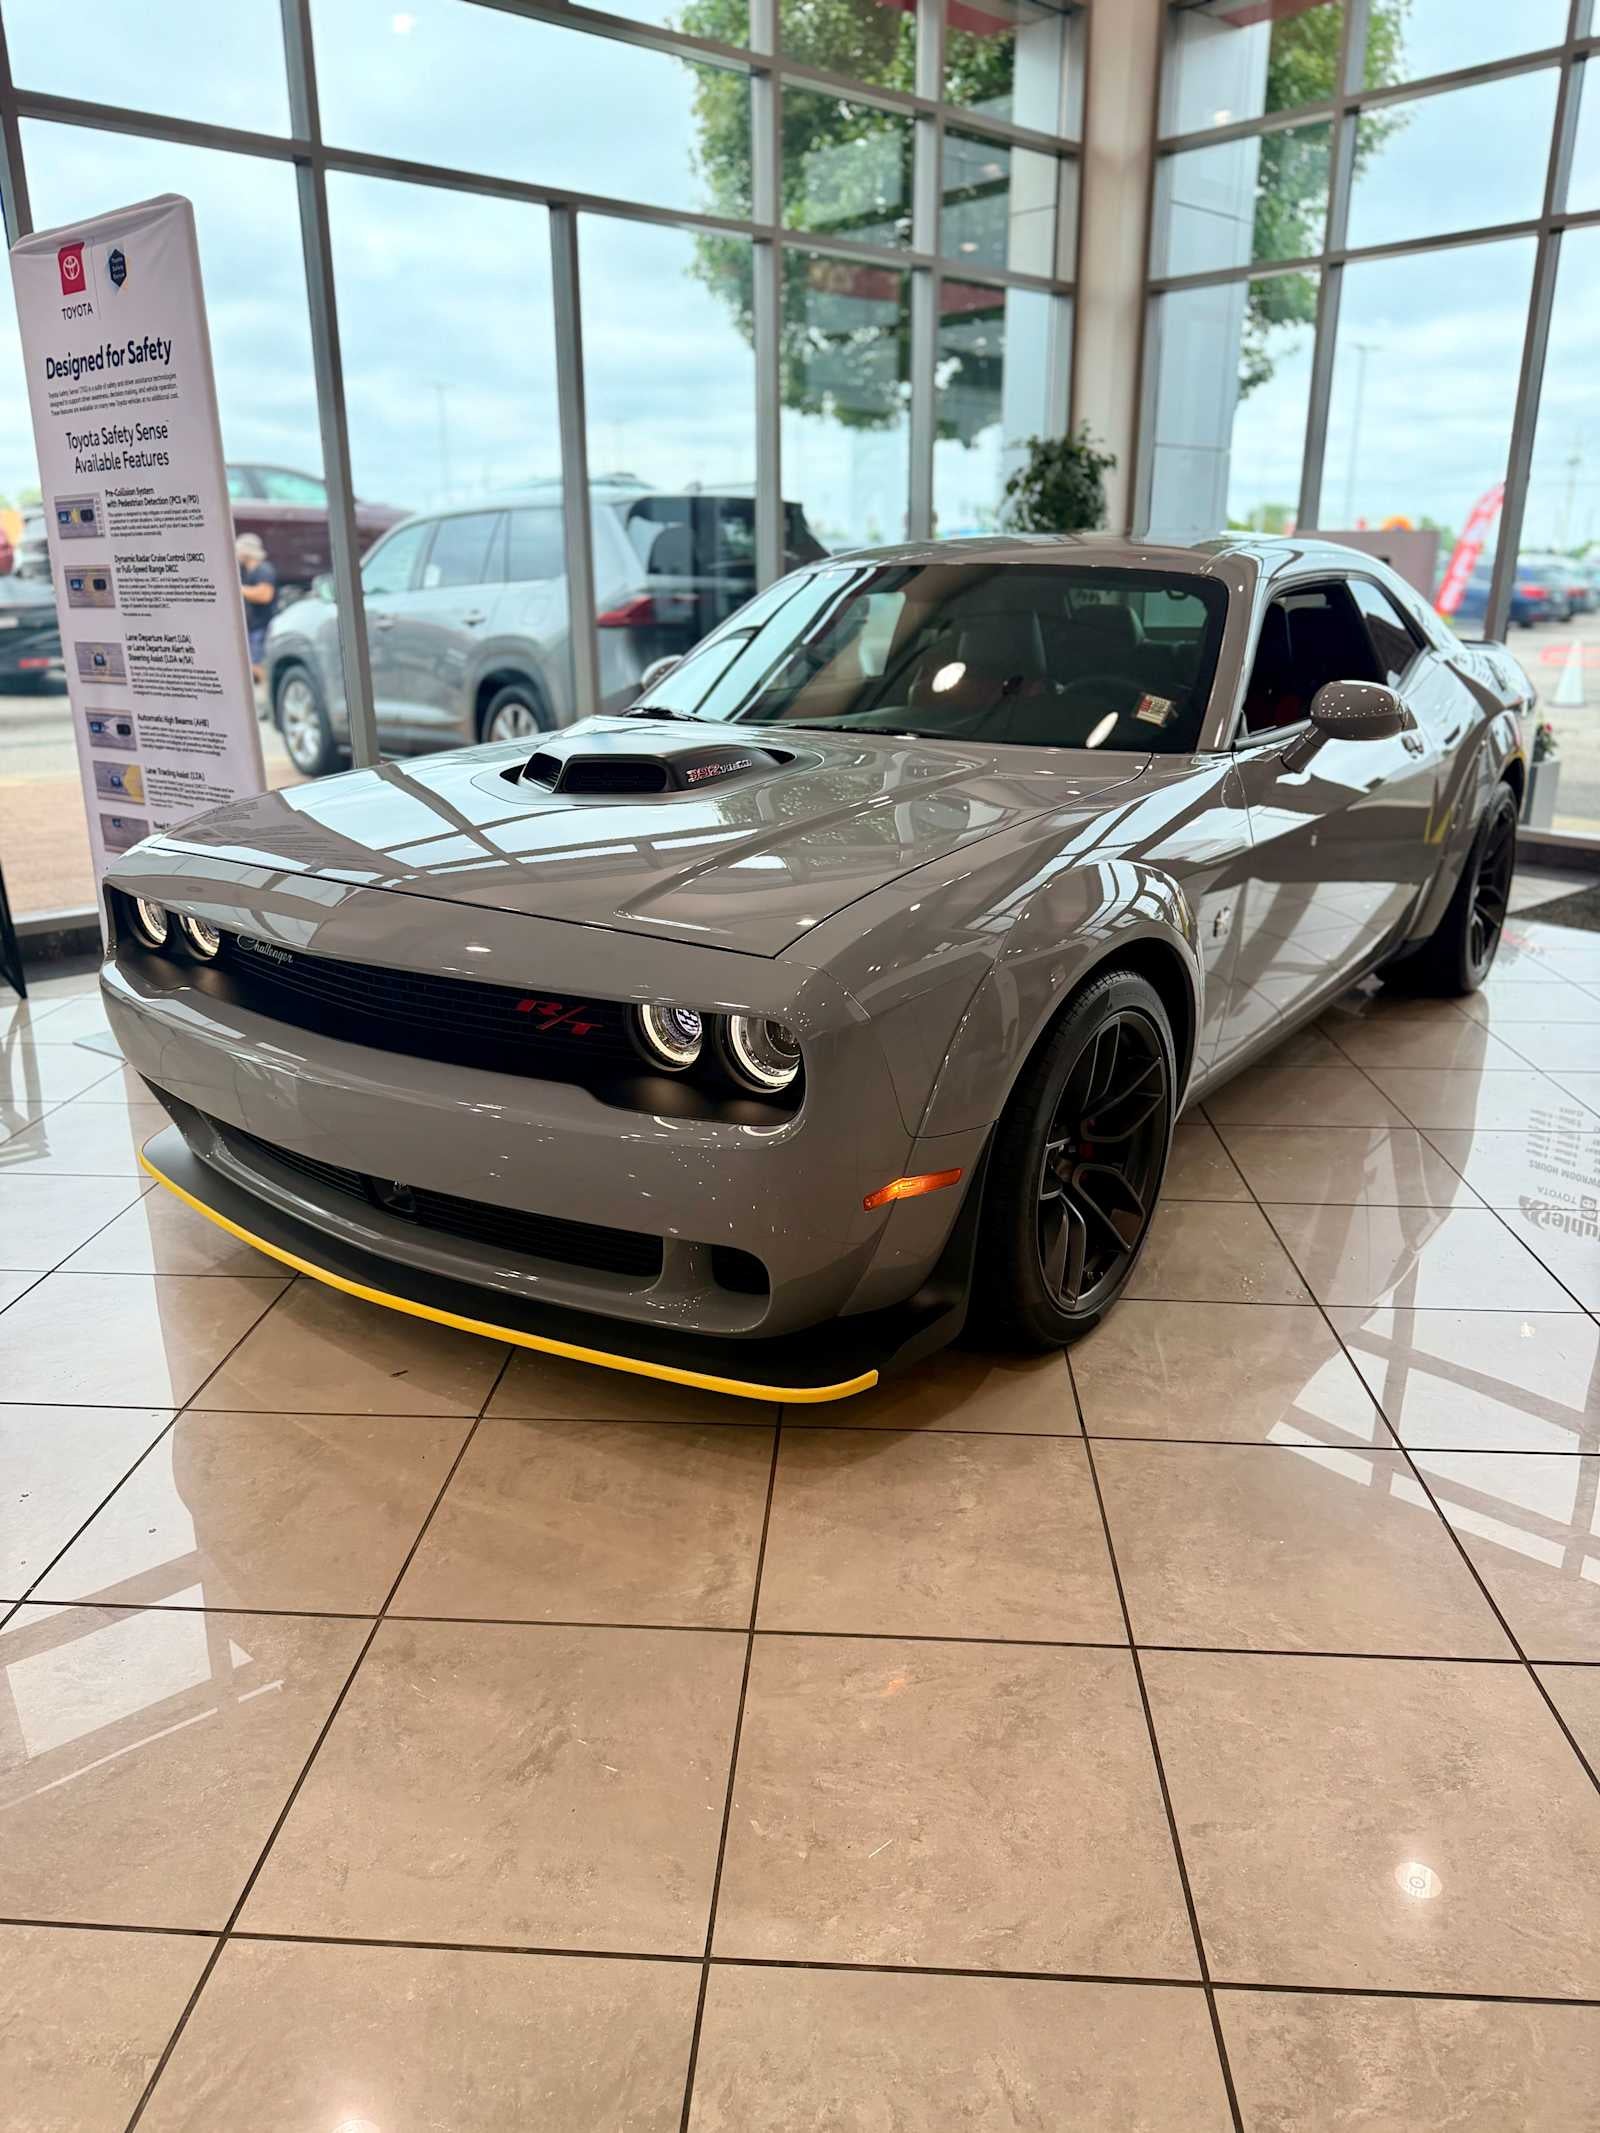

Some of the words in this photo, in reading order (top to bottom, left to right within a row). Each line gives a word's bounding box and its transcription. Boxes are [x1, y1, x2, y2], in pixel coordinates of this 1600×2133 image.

[61, 302, 93, 320] TOYOTA
[46, 345, 103, 381] Designed
[106, 343, 125, 369] for
[128, 337, 172, 364] Safety
[66, 429, 100, 453] Toyota
[101, 425, 134, 448] Safety
[136, 423, 168, 440] Sense
[75, 455, 121, 473] Available
[123, 451, 169, 468] Features
[105, 488, 135, 496] Pre-Collision
[136, 487, 154, 496] System
[118, 499, 143, 507] Pedestrian
[114, 555, 135, 564] Dynamic
[136, 554, 150, 562] Radar
[151, 553, 166, 562] Cruise
[167, 553, 185, 562] Control
[149, 564, 164, 575] Range
[125, 633, 137, 641] Lane
[139, 633, 162, 642] Departure
[164, 634, 176, 642] Alert
[146, 644, 170, 652] Departure
[138, 713, 162, 722] Automatic
[236, 933, 294, 964] Challenger
[514, 998, 604, 1036] R/T
[1528, 1158, 1560, 1176] HOURS
[1537, 1186, 1577, 1205] TOYOTA
